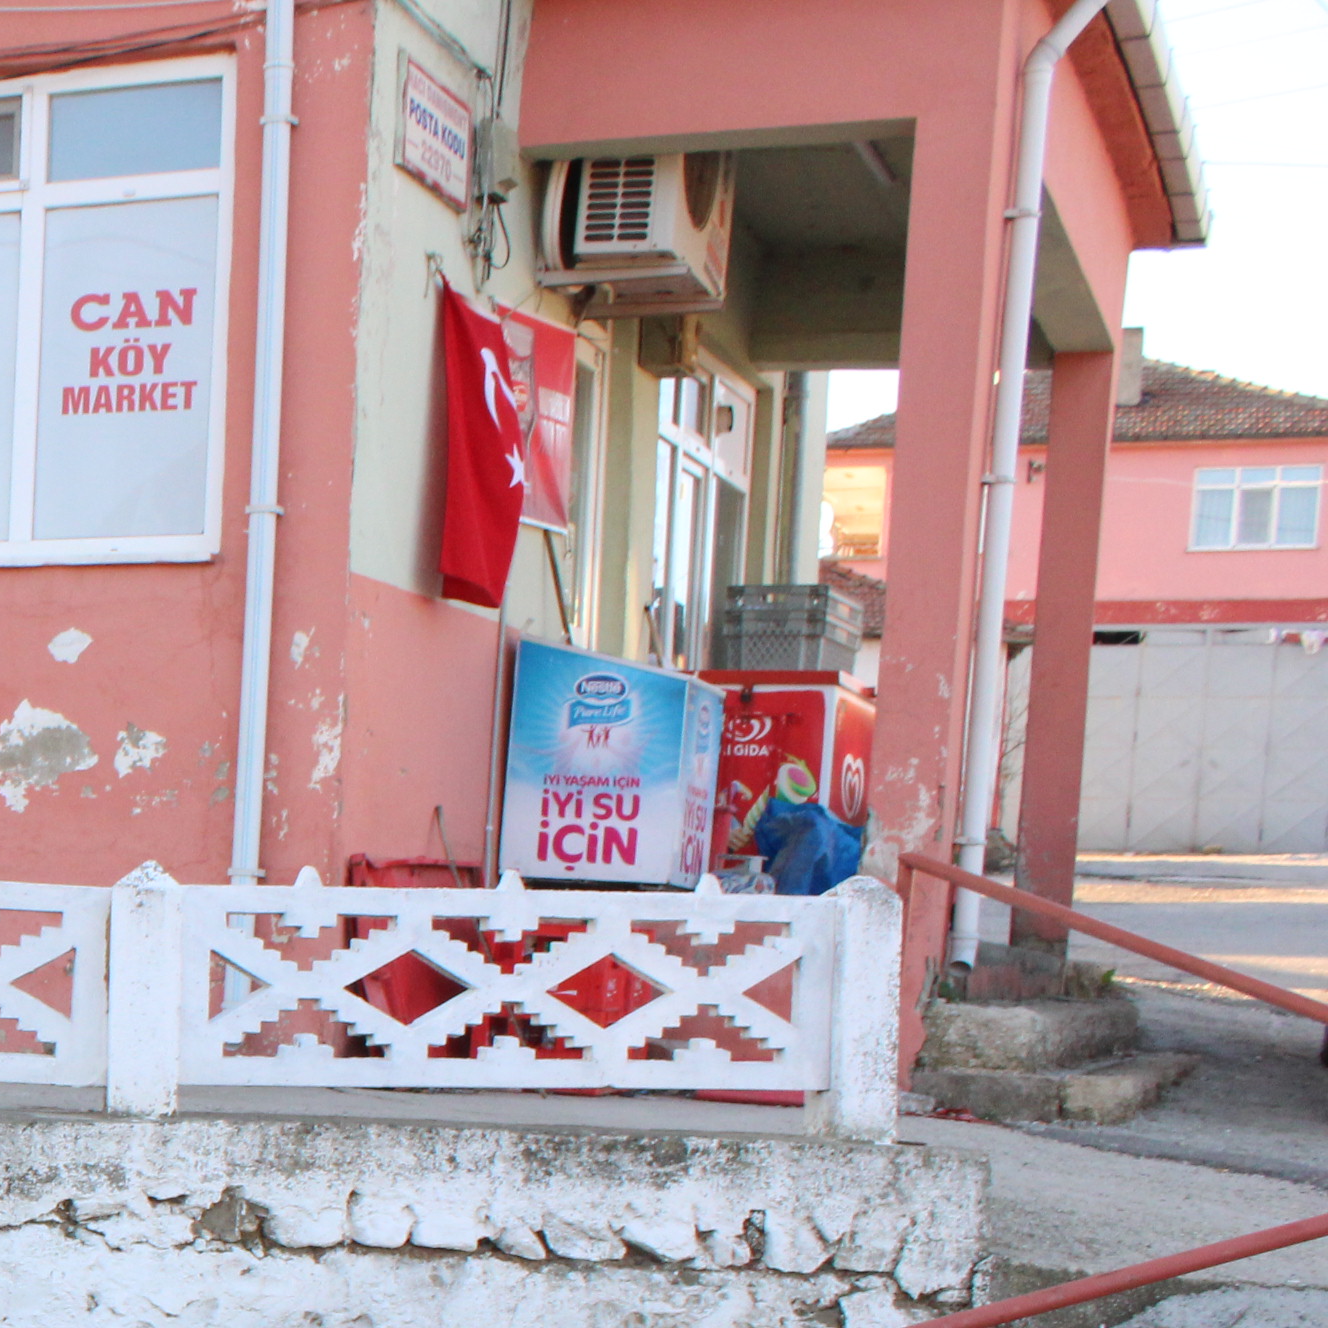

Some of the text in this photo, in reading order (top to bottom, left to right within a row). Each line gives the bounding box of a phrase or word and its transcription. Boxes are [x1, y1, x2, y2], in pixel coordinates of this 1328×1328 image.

[408, 97, 466, 160] POSTA KODU
[70, 287, 198, 332] CAN
[89, 337, 173, 378] KÖY
[61, 380, 198, 416] MARKET
[563, 774, 610, 788] YAŞAM
[592, 792, 641, 822] SU
[537, 819, 638, 872] İÇİN
